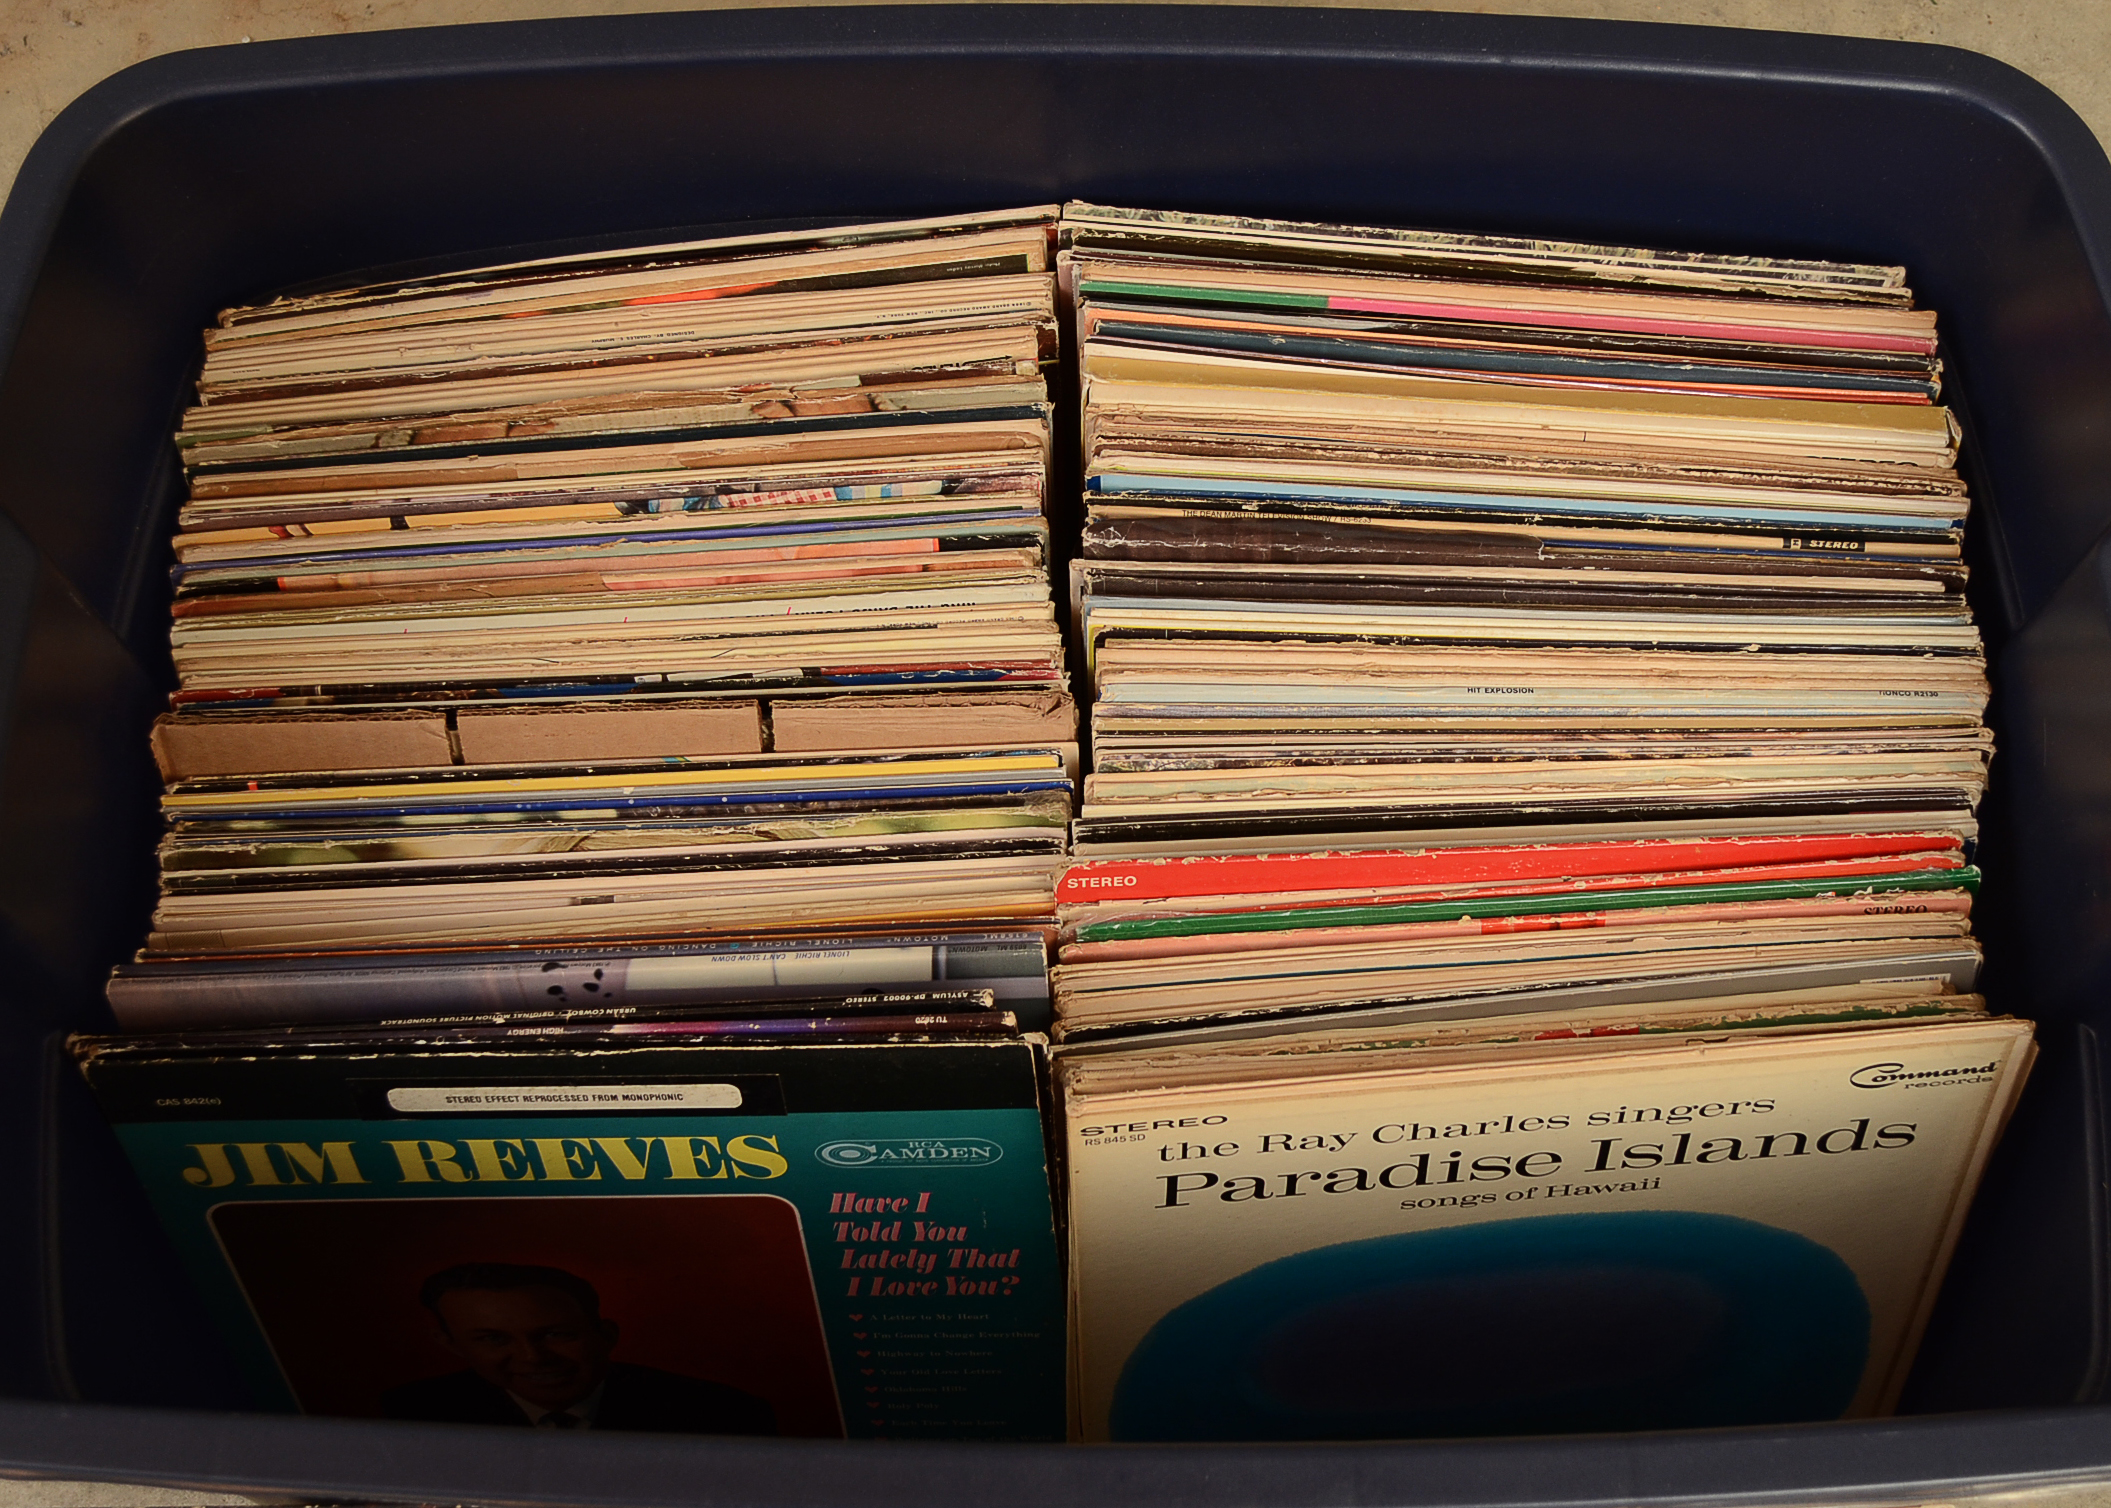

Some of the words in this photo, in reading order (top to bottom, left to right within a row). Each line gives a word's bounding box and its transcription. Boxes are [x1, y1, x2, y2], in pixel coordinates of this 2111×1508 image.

[1225, 511, 1255, 519] MARTIN
[1809, 540, 1859, 549] STEREO
[1067, 876, 1137, 889] STEREO
[1864, 904, 1928, 915] STEREO
[807, 938, 853, 946] LIONEL
[893, 935, 949, 943] MOTOWN
[659, 943, 717, 951] DANCING
[738, 954, 761, 962] SLOW
[763, 953, 787, 961] CAN'T
[795, 952, 821, 960] RICHIE
[823, 950, 850, 958] LIONEL
[606, 1007, 637, 1015] URBAN
[381, 1018, 438, 1026] SOUNDTRACK
[440, 1015, 474, 1023] PICTURE
[507, 1027, 545, 1036] ENERGY
[546, 1027, 564, 1035] HIGH
[1850, 1061, 1998, 1089] Command
[1904, 1075, 1993, 1089] records
[156, 1098, 181, 1106] CAS
[183, 1097, 222, 1107] 842(e)
[445, 1095, 482, 1104] STEREO
[485, 1095, 520, 1104] EFFECT
[523, 1094, 589, 1103] REPROCESSED
[592, 1094, 619, 1102] FROM
[622, 1093, 683, 1102] MONOPHONIC
[1080, 1115, 1228, 1137] STEREO
[1157, 1141, 1240, 1162] the
[1256, 1132, 1359, 1154] Ray
[1372, 1114, 1570, 1144] Charles
[1587, 1098, 1776, 1127] singers
[1084, 1137, 1101, 1146] RS
[1103, 1135, 1127, 1145] 845
[1129, 1133, 1146, 1142] SD
[908, 1141, 946, 1149] RCA
[821, 1142, 992, 1166] CAMDEN
[182, 1140, 373, 1188] JIM
[380, 1134, 789, 1183] REEVES
[1155, 1150, 1563, 1209] Paradise
[1584, 1118, 1918, 1173] Islands
[1400, 1192, 1497, 1210] songs
[1505, 1186, 1538, 1202] of
[1544, 1177, 1661, 1199] Hawaii
[827, 1191, 909, 1214] Have
[913, 1191, 933, 1214] I
[833, 1221, 902, 1242] Told
[912, 1220, 969, 1242] You
[839, 1248, 938, 1274] Lately
[947, 1248, 1020, 1269] That
[846, 1276, 861, 1297] I
[869, 1276, 939, 1297] Love
[945, 1275, 1020, 1296] You?
[935, 1313, 953, 1321] My
[979, 1331, 1040, 1339] Everything
